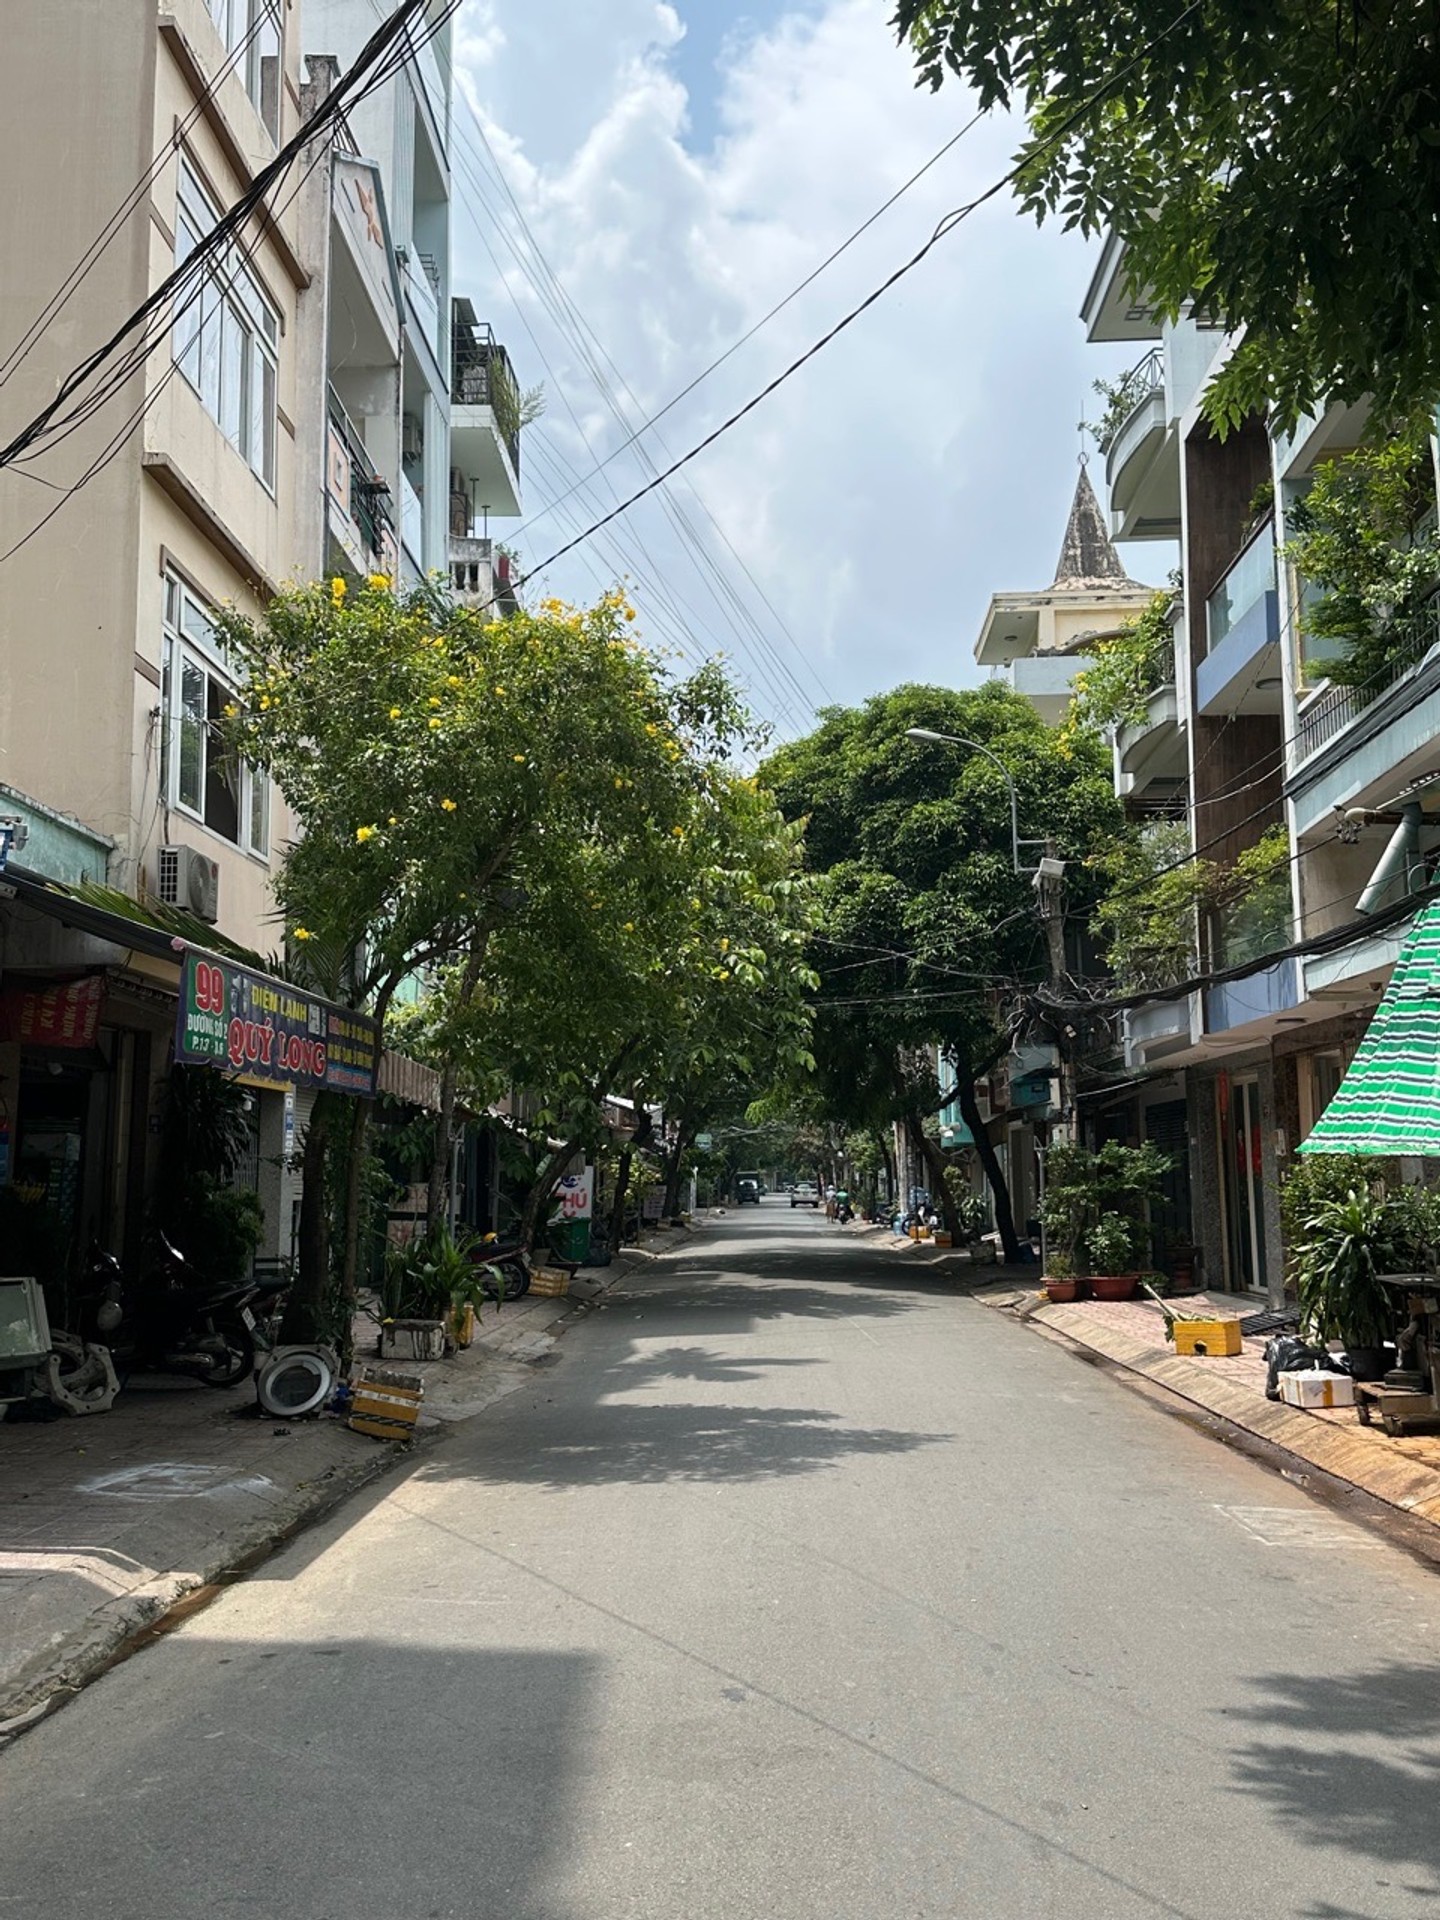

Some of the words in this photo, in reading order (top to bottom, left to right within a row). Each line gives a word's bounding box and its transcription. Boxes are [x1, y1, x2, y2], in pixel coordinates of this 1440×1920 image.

[195, 961, 225, 1017] 99
[251, 984, 277, 1014] ĐIỆN
[280, 995, 307, 1023] LẠNH
[187, 1011, 214, 1036] ĐƯỜNG
[214, 1016, 224, 1039] SỐ
[227, 1017, 275, 1067] QUÝ
[277, 1030, 326, 1078] LONG
